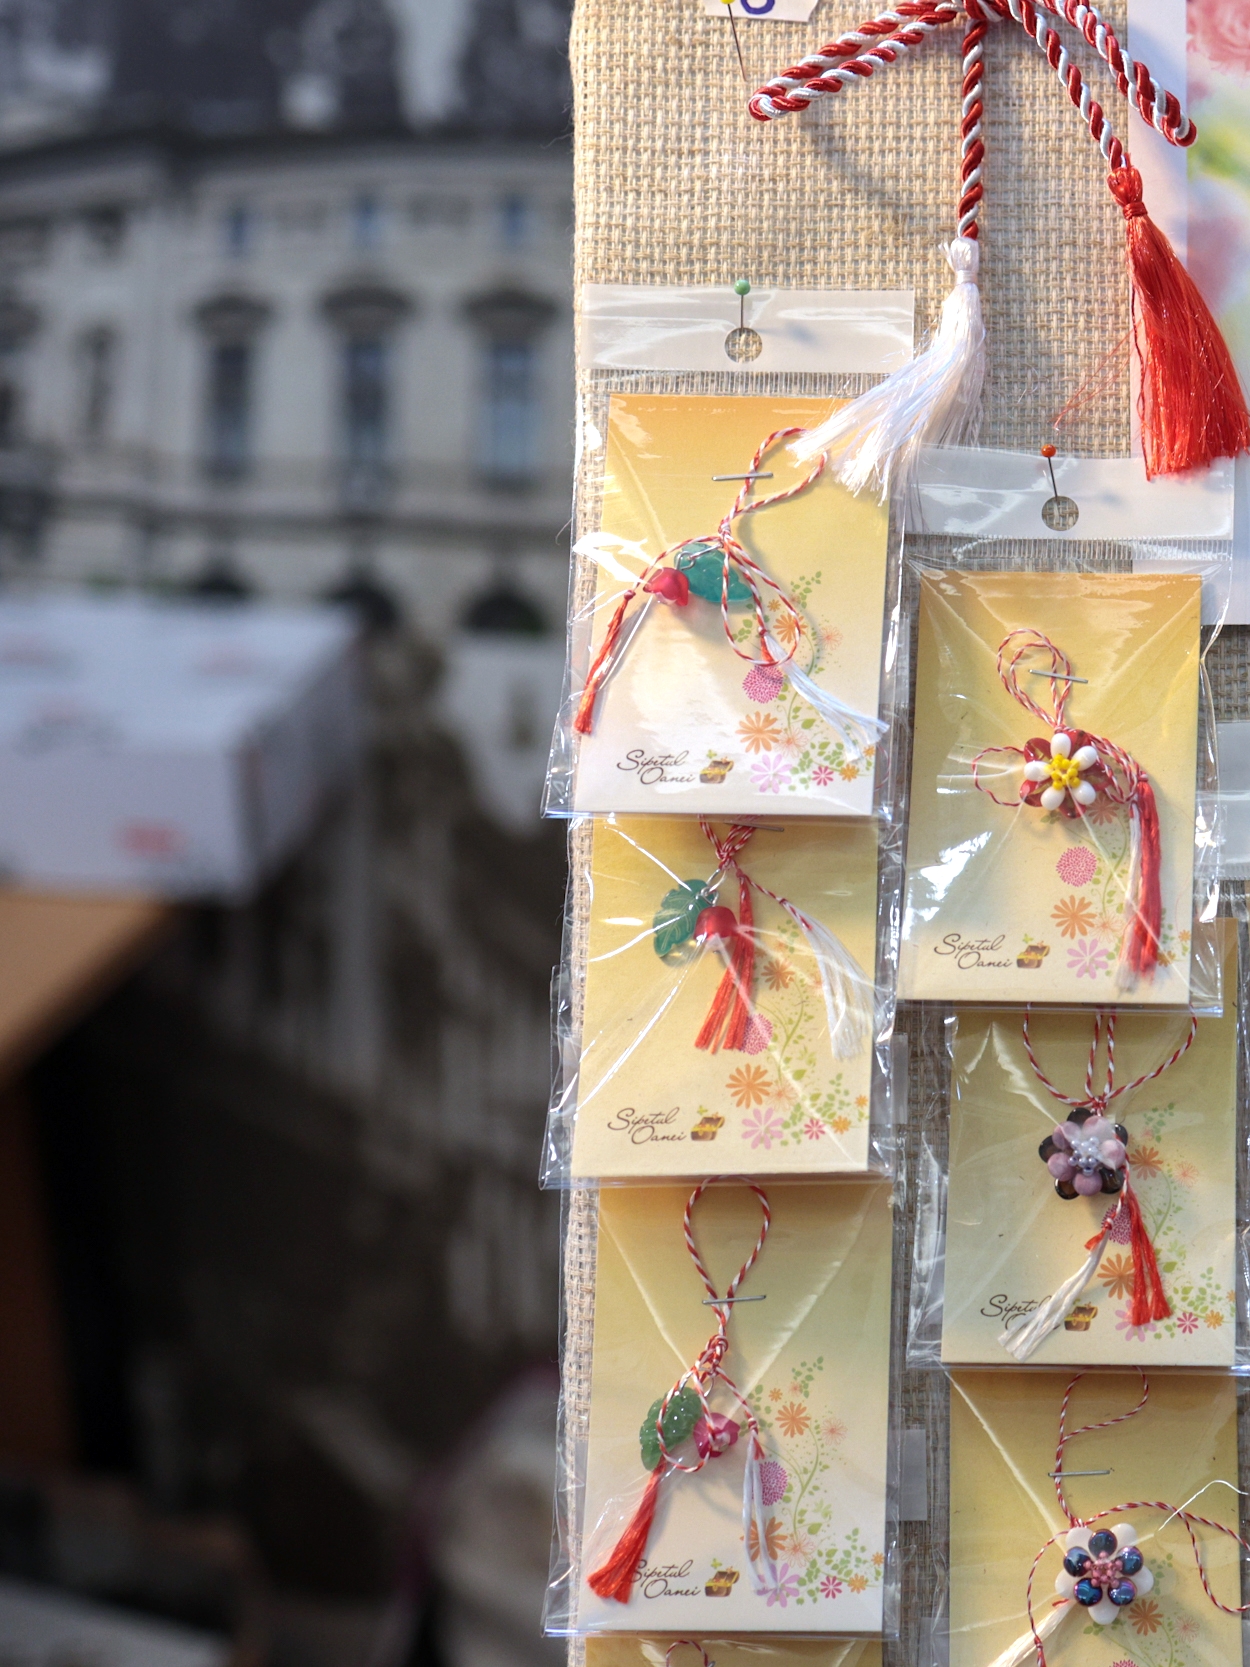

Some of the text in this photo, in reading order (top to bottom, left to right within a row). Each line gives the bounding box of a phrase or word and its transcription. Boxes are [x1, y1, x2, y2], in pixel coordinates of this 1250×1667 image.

[617, 749, 689, 774] Sipetul
[640, 766, 696, 785] Oanei
[934, 933, 1006, 959] Sipetul
[957, 951, 1013, 970] Oanei
[607, 1107, 680, 1134] Sipetul
[631, 1126, 687, 1145] Oanei
[643, 1578, 701, 1600] Oanei
